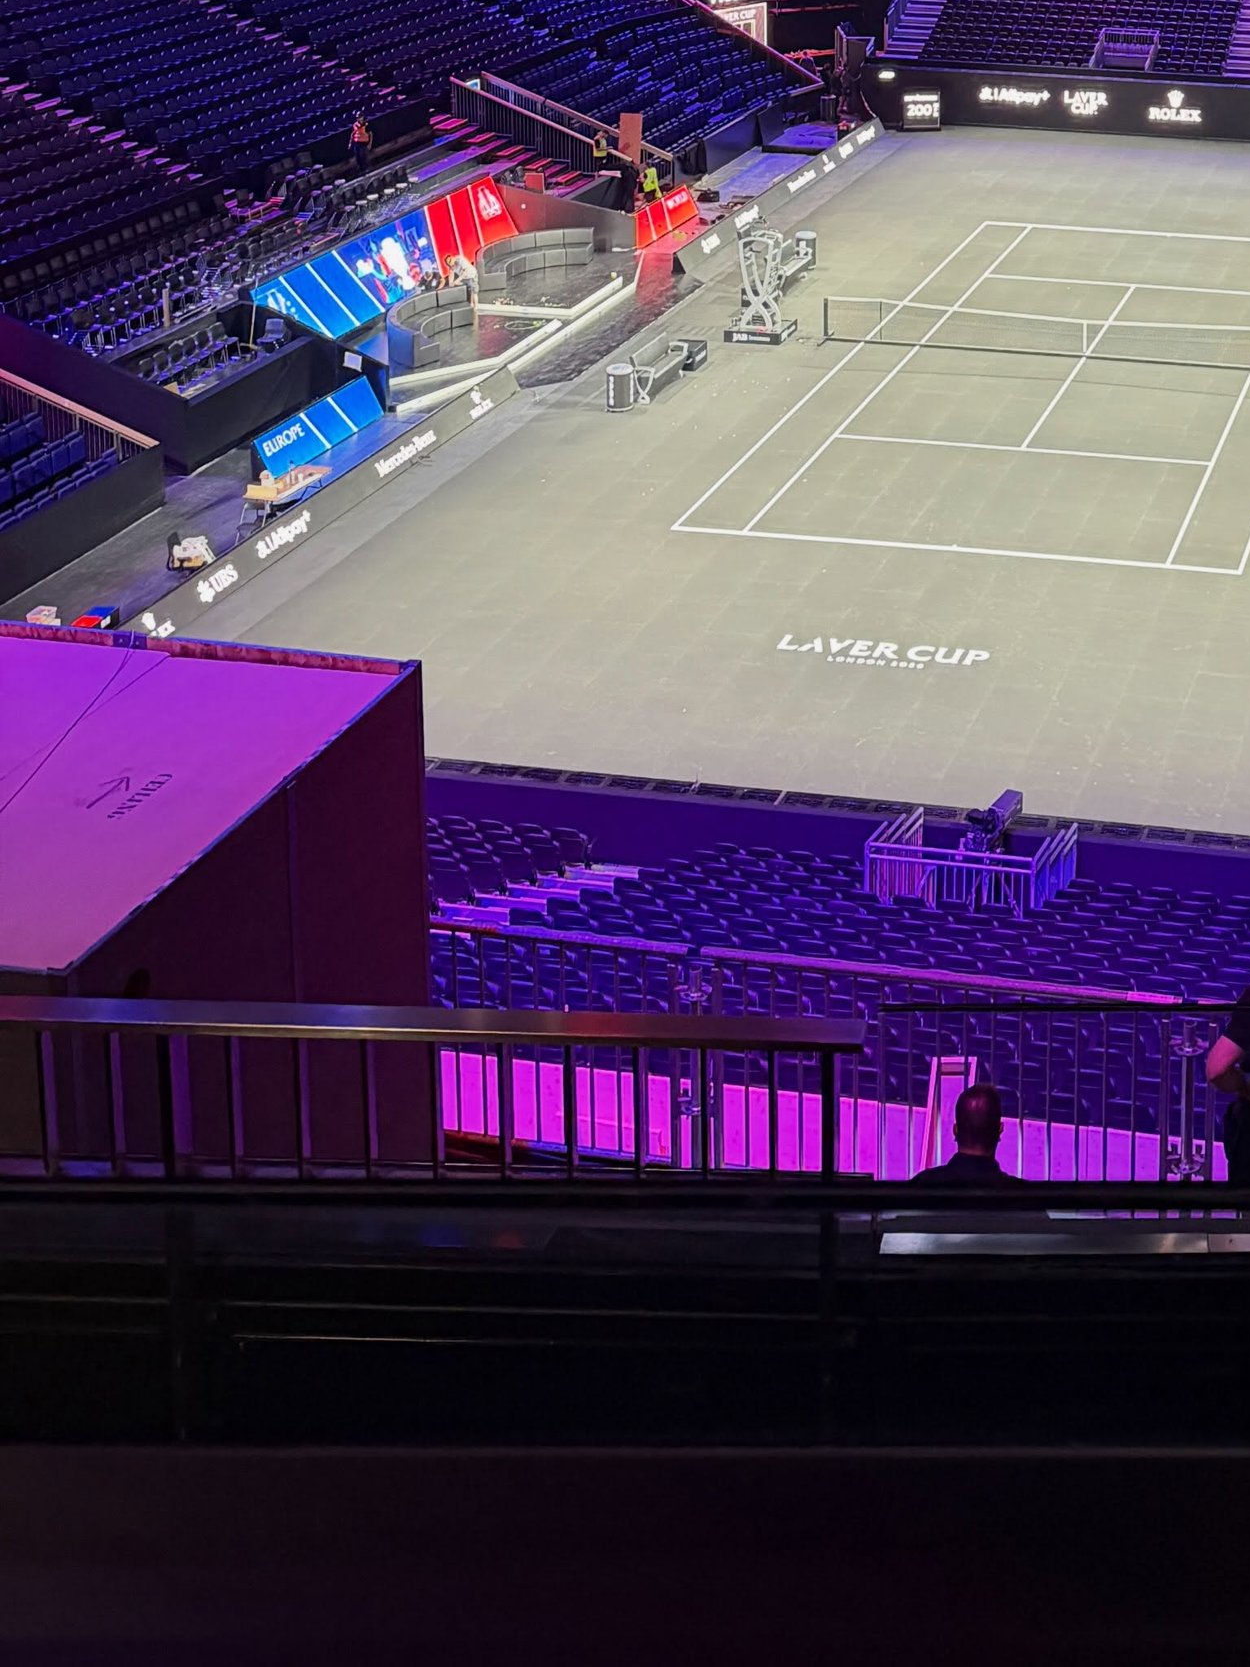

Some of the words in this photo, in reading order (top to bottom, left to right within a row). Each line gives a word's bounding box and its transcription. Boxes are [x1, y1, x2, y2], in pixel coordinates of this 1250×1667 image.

[1063, 90, 1109, 107] LAVER
[1148, 106, 1202, 124] ROLEX
[263, 422, 306, 458] EUROPE
[374, 430, 437, 478] Mercedes-Benz
[212, 564, 239, 592] UBS
[776, 633, 899, 660] LAVER
[906, 645, 991, 666] CUP
[826, 654, 886, 667] LONDON
